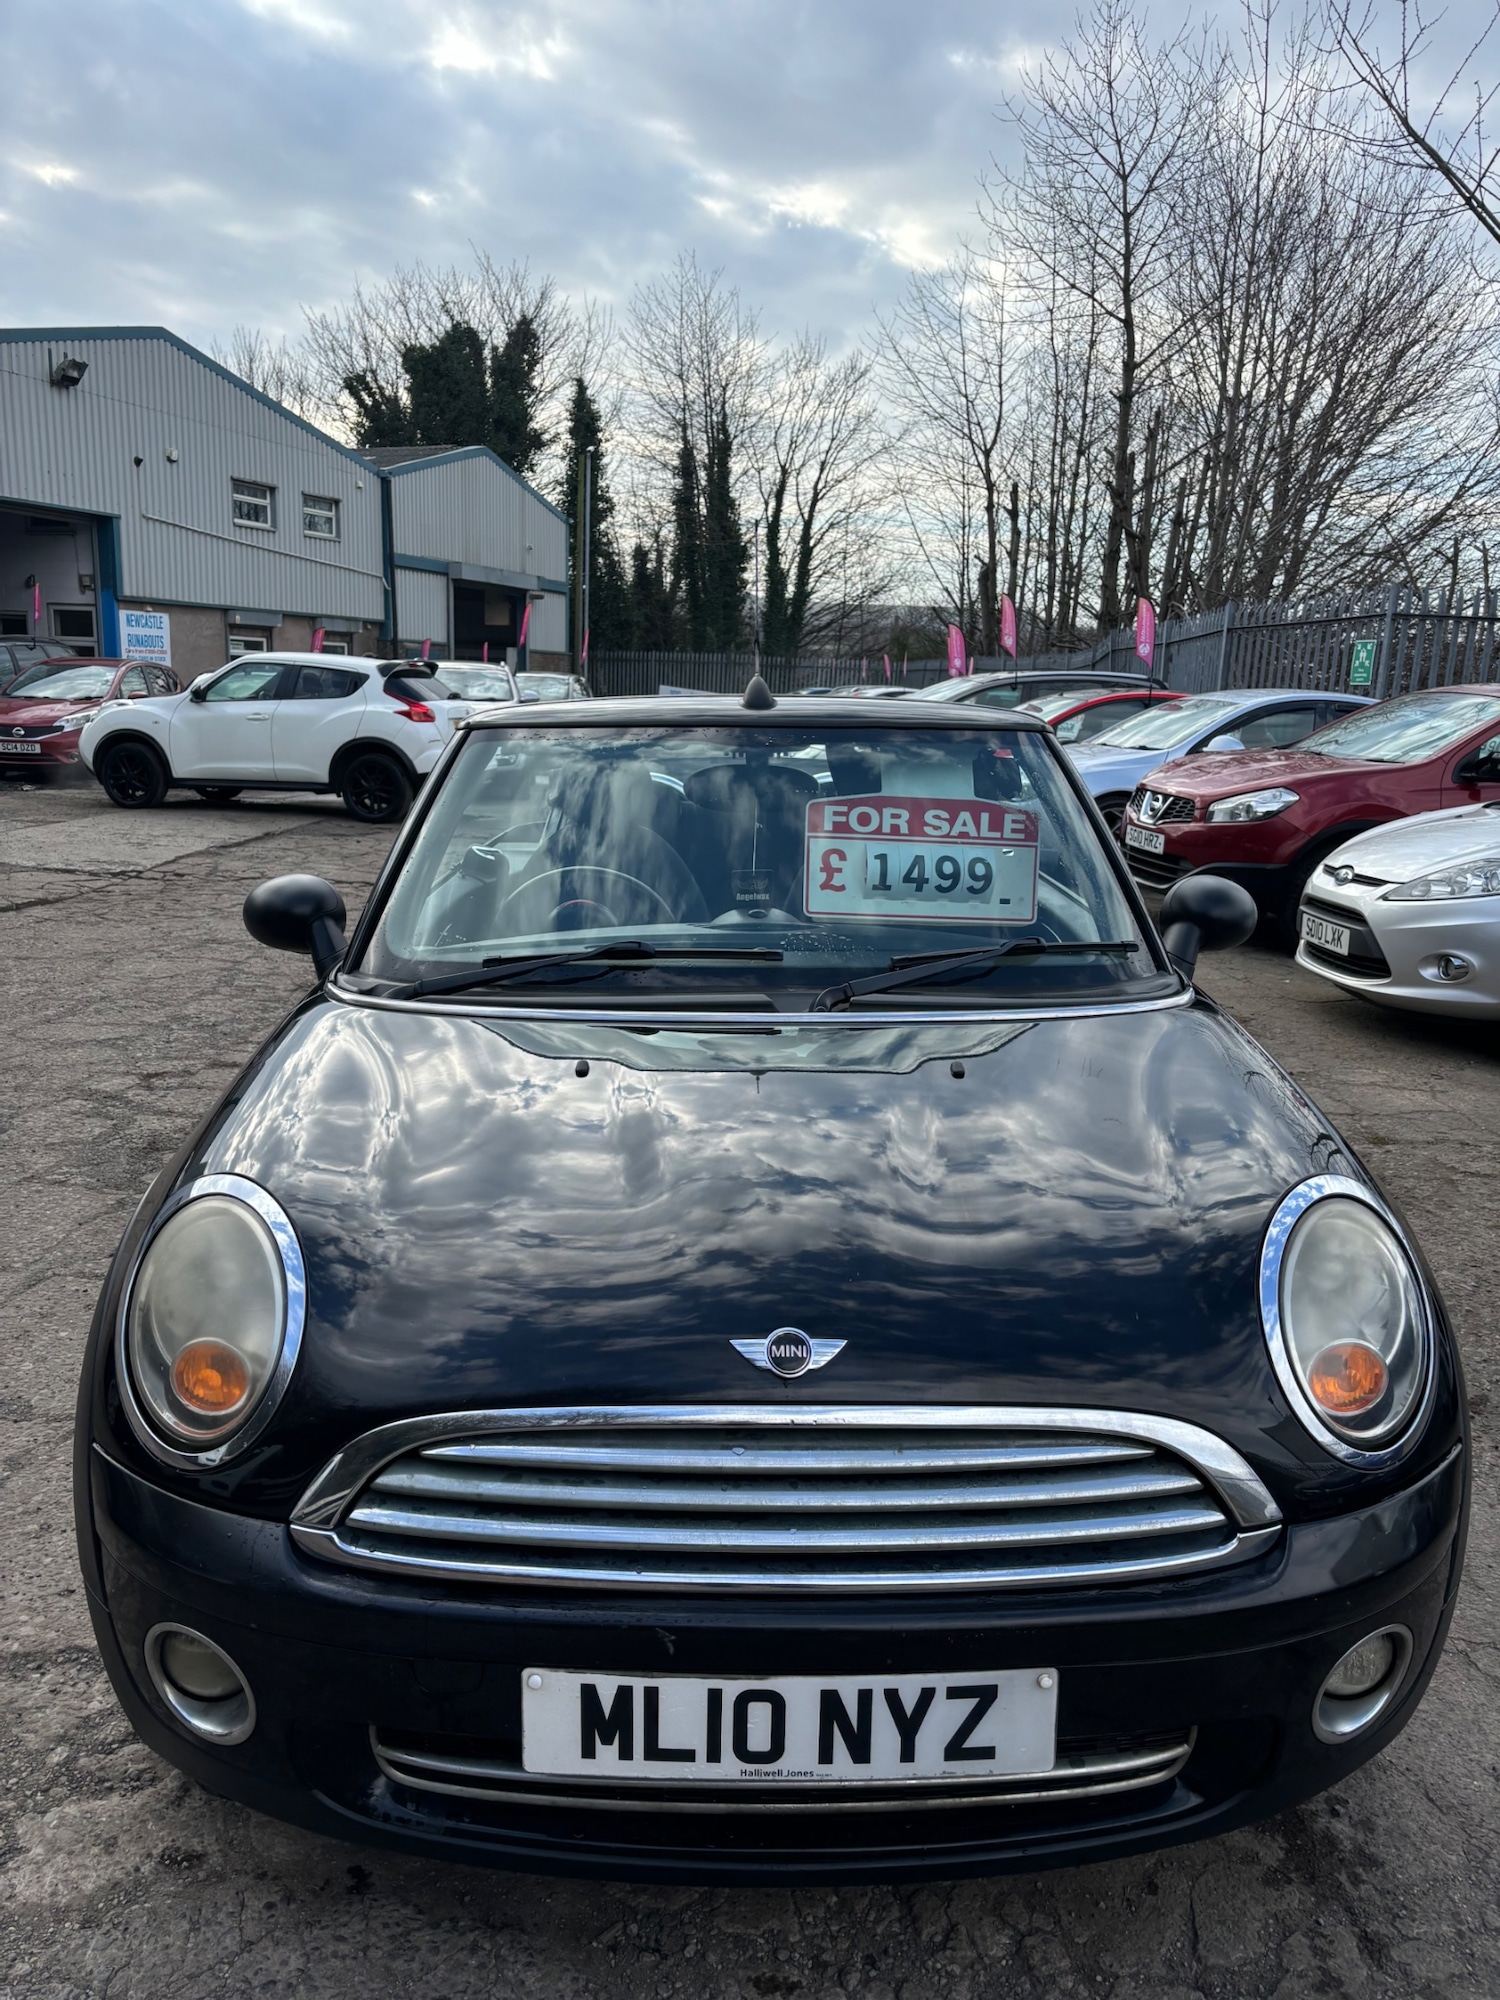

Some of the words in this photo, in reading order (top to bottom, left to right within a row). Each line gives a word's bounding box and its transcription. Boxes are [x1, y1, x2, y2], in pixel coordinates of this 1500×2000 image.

[126, 613, 164, 630] NEWCASTLE
[127, 633, 164, 649] RUNABOUTS
[1, 743, 18, 751] SC14
[823, 805, 910, 835] FOR
[923, 809, 1026, 840] SALE
[1144, 832, 1160, 849] HRZ
[819, 848, 847, 893] £
[872, 853, 994, 895] 1499
[736, 892, 770, 901] Angelwax
[1305, 917, 1324, 941] SD10
[1324, 924, 1344, 950] LXK
[771, 1344, 807, 1358] MINI
[580, 1683, 787, 1765] ML10
[818, 1684, 999, 1765] NYZ
[740, 1768, 783, 1778] Halliwell
[783, 1769, 814, 1778] Jones
